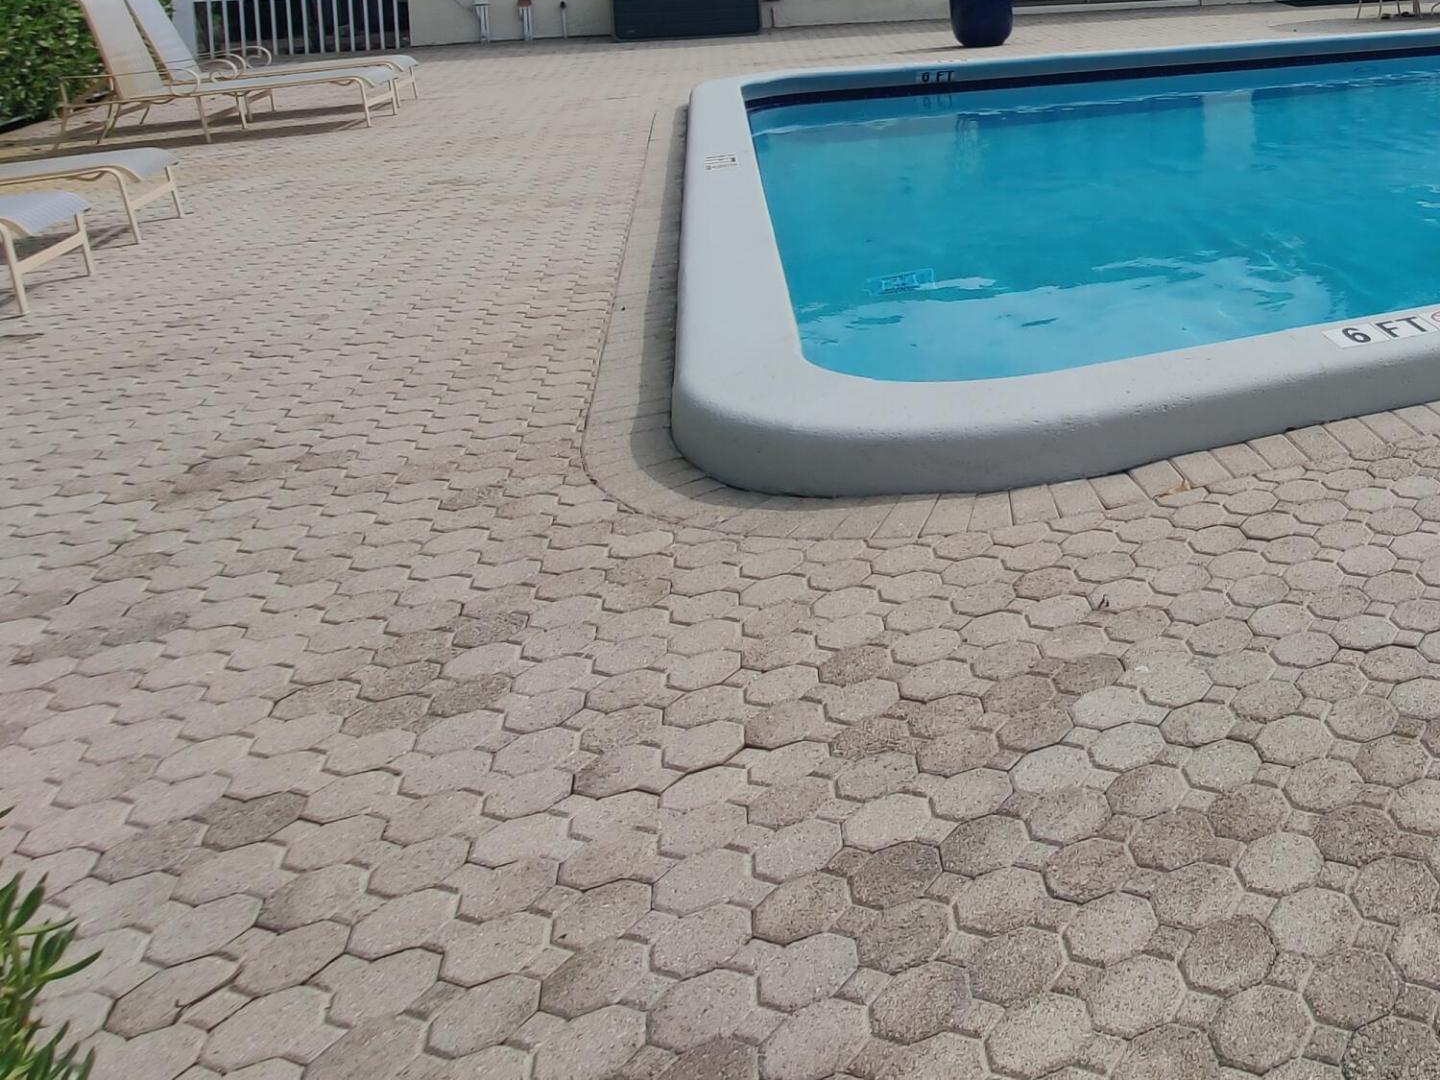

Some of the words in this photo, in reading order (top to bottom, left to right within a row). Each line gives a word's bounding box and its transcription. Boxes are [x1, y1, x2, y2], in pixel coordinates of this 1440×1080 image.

[936, 70, 955, 82] FT
[1342, 327, 1371, 343] 6
[1376, 316, 1427, 337] FT
